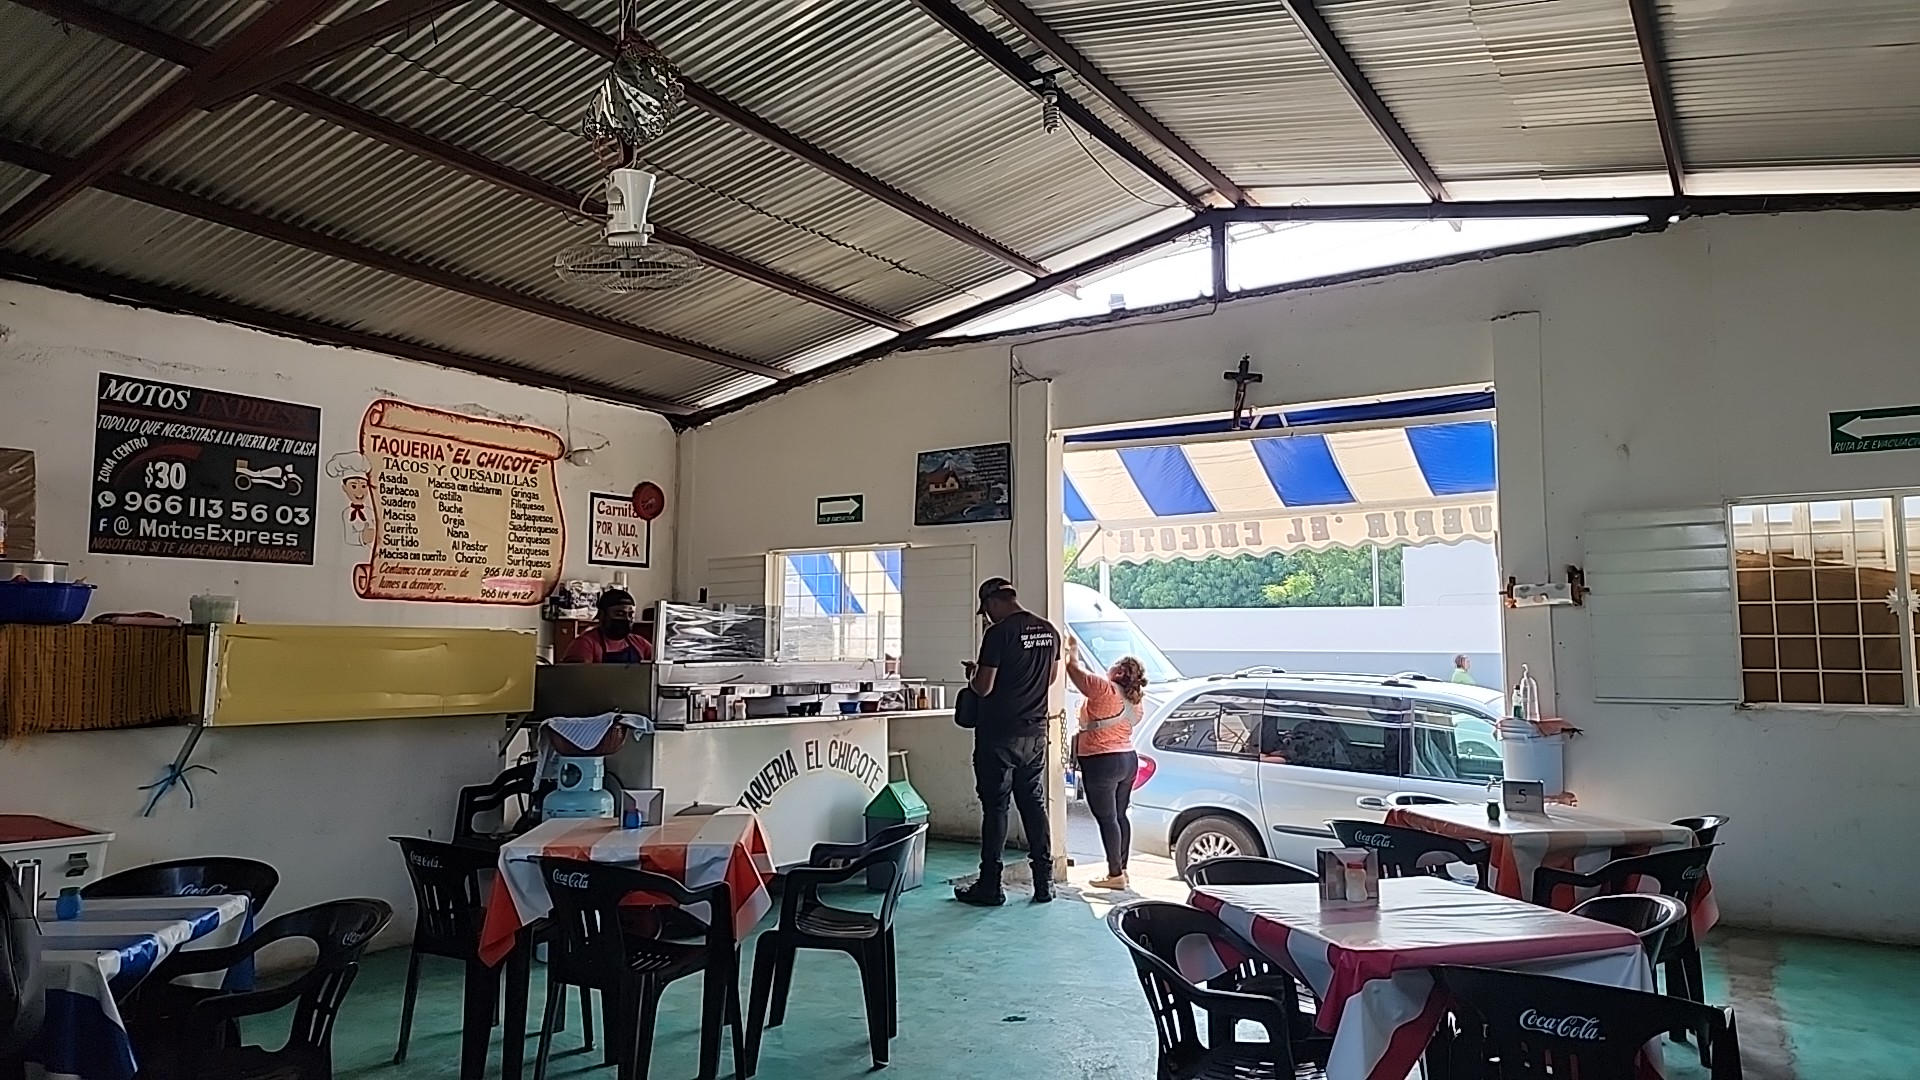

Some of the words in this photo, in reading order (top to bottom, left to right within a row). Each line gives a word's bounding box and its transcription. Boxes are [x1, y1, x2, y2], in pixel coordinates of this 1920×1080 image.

[100, 378, 192, 411] MOTOS
[197, 393, 308, 427] EXPRES
[97, 414, 126, 431] TODO
[124, 418, 139, 433] LO
[139, 419, 163, 436] QUE
[162, 422, 216, 446] NECESITAS
[214, 431, 221, 445] A
[221, 432, 235, 446] LA
[235, 433, 267, 450] PUERTA
[267, 437, 280, 452] DE
[281, 438, 294, 454] TU
[293, 440, 317, 457] CASA
[370, 434, 445, 462] TAQUERIA
[1833, 441, 1855, 452] RUTA
[1856, 440, 1870, 450] DE
[98, 459, 118, 484] ZONA
[112, 436, 148, 460] CENTRO
[145, 461, 187, 490] $30
[379, 472, 408, 485] Asada
[383, 457, 429, 474] TACOS
[433, 463, 447, 477] Y
[450, 466, 539, 488] QUESADILLAS
[379, 483, 419, 497] Barbacoa
[428, 477, 456, 491] Macisa
[457, 483, 468, 492] con
[433, 489, 462, 502] Costilla
[511, 487, 539, 502] Gringas
[124, 490, 184, 515] 966
[189, 496, 224, 520] 113
[230, 500, 269, 523] 56
[275, 505, 311, 526] 03
[381, 496, 416, 509] Suadero
[439, 501, 463, 514] Buche
[511, 498, 545, 512] Filiquesos
[597, 500, 639, 518] Carnita
[383, 508, 416, 521] Macisa
[442, 513, 465, 528] Oreja
[510, 508, 554, 525] Barbaquesos
[138, 518, 299, 547] MotosExpress
[384, 521, 418, 535] Cuerito
[447, 526, 470, 538] Nana
[596, 520, 613, 535] POR
[617, 522, 638, 538] KILO.
[383, 533, 419, 547] Surtido
[452, 540, 460, 551] Al
[461, 540, 488, 552] Pastor
[508, 532, 551, 547] Choriquesos
[91, 537, 146, 553] NOSOTROS
[150, 540, 161, 553] SI
[161, 540, 176, 554] TE
[177, 542, 230, 557] HACEMOS
[232, 546, 250, 559] LOS
[250, 547, 306, 561] MANDADOS
[378, 547, 408, 560] Macisa
[410, 553, 420, 561] con
[422, 549, 447, 561] cuerito
[507, 544, 550, 559] Maxiquesos
[614, 545, 620, 559] y
[631, 543, 639, 557] K
[455, 552, 487, 564] Chorizo
[507, 555, 552, 571] Surtiquesos
[379, 561, 417, 575] Contamos
[417, 566, 431, 576] con
[432, 566, 459, 577] servicio
[459, 566, 470, 578] de
[483, 566, 501, 577] 966
[501, 567, 515, 577] 118
[515, 568, 529, 578] 36
[530, 570, 542, 578] 03
[379, 575, 401, 589] lunes
[401, 580, 408, 589] a
[481, 588, 497, 599] 966
[497, 590, 510, 599] 114
[1024, 640, 1035, 649] SOY
[736, 749, 799, 815] TAQUERIA
[805, 740, 823, 770] EL
[828, 739, 884, 793] CHICOTE
[1515, 788, 1528, 804] 5
